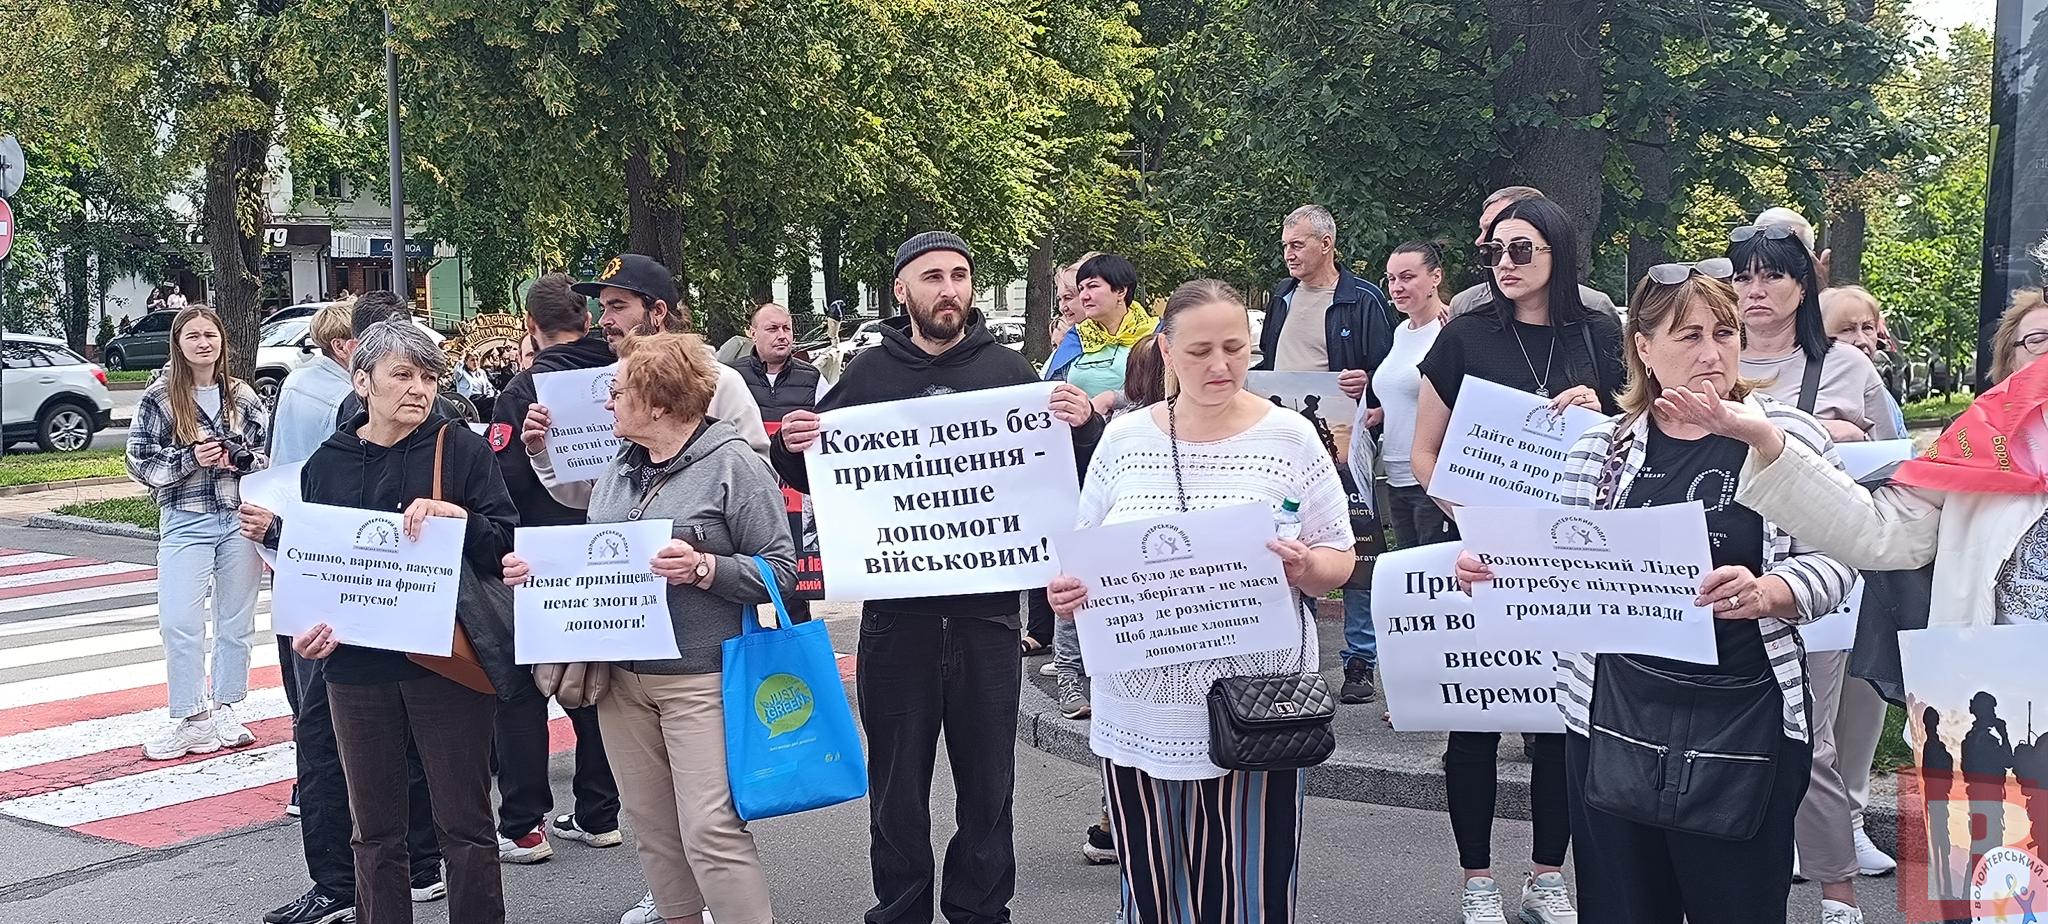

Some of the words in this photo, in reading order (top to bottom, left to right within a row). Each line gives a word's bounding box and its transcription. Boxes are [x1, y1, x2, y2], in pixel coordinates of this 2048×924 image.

[551, 426, 583, 438] Ваша
[819, 428, 920, 456] Кожен
[930, 418, 998, 447] день
[1006, 408, 1052, 434] без
[1467, 423, 1514, 447] Дайте
[555, 445, 569, 454] це
[572, 438, 602, 452] сотні
[567, 456, 604, 468] бійців
[834, 446, 1025, 490] приміщення
[1463, 445, 1506, 468] стіни,
[1510, 460, 1519, 470] а
[1522, 464, 1548, 479] про
[1552, 472, 1564, 484] р
[1449, 463, 1485, 480] вони
[1489, 478, 1560, 503] подбають
[893, 484, 995, 512] менше
[876, 514, 1022, 546] допомоги
[286, 548, 346, 567] Сушимо,
[350, 556, 402, 572] варимо,
[406, 563, 453, 578] пакуємо
[864, 536, 1050, 574] військовим!
[1478, 552, 1634, 574] Волонтерський
[1640, 560, 1700, 580] Лідер
[320, 572, 372, 587] хлопців
[376, 579, 392, 589] на
[395, 578, 436, 594] фронті
[523, 574, 572, 588] Немає
[1100, 575, 1128, 588] Нас
[1132, 570, 1166, 587] було
[1169, 569, 1185, 580] де
[1190, 559, 1247, 577] варити,
[1404, 570, 1462, 600] При
[1492, 574, 1581, 594] потребує
[1586, 577, 1697, 597] підтримки
[340, 591, 398, 607] рятуємо!
[543, 597, 588, 610] немає
[593, 595, 638, 608] змоги
[1137, 584, 1206, 604] зберігати
[1219, 580, 1236, 592] не
[1240, 575, 1279, 589] маєм
[564, 614, 646, 632] допомоги!
[1105, 614, 1144, 630] зараз
[1156, 608, 1172, 621] де
[1176, 597, 1262, 620] розмістити,
[1388, 614, 1436, 636] для
[1446, 612, 1476, 631] во
[1505, 602, 1591, 622] громади
[1597, 604, 1620, 616] та
[1627, 604, 1684, 622] влади
[1115, 630, 1146, 645] Щоб
[1149, 622, 1198, 640] дальше
[1201, 614, 1259, 632] хлопцям
[1145, 634, 1236, 659] допомогати!!!
[1444, 650, 1542, 668] внесок
[768, 695, 806, 719] GREEN
[1974, 850, 2044, 909] ВОЛОНТЕРСЬКИЙ
